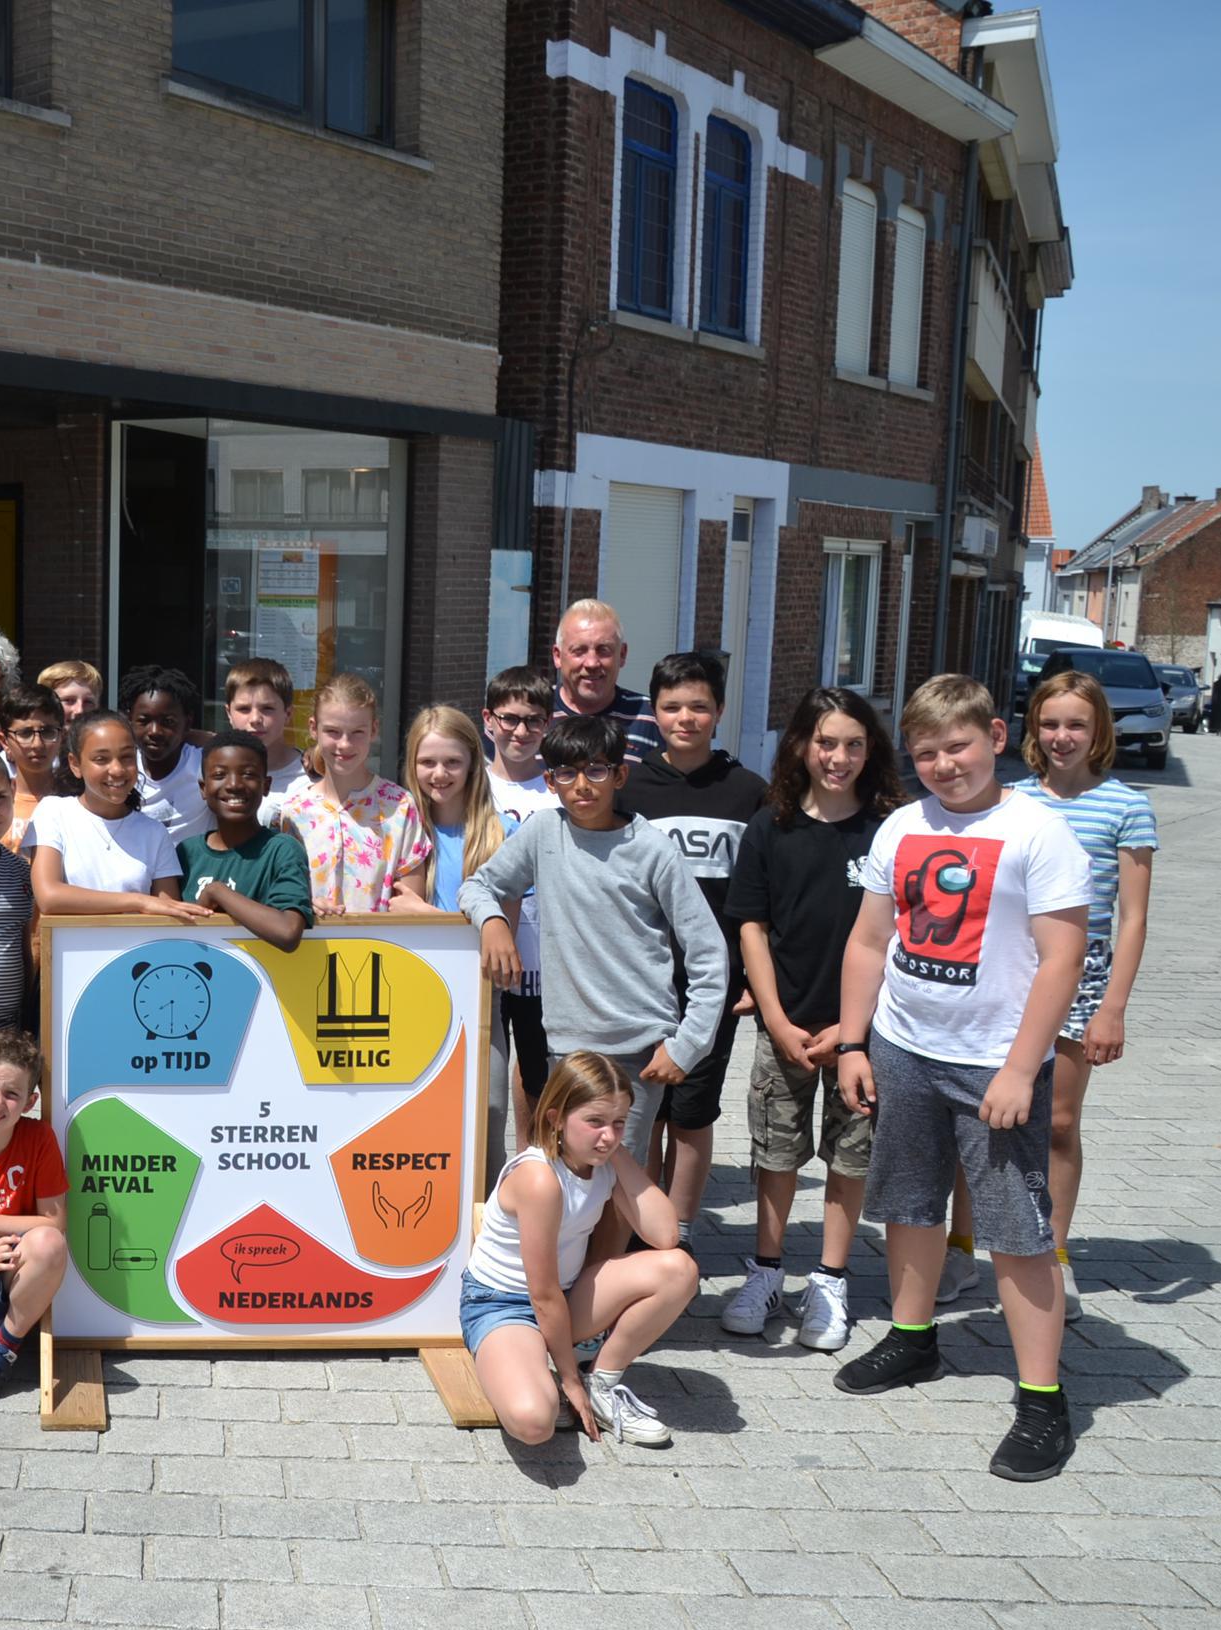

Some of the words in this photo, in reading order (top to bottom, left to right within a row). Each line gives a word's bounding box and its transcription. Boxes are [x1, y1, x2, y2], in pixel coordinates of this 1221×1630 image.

[668, 828, 732, 859] ASA
[131, 1054, 158, 1073] op
[162, 1051, 211, 1072] TIJD
[317, 1050, 391, 1068] VEILIG
[258, 1101, 271, 1118] 5
[210, 1125, 318, 1143] STERREN
[82, 1154, 178, 1173] MINDER
[218, 1152, 311, 1171] SCHOOL
[351, 1152, 451, 1171] RESPECT
[81, 1176, 154, 1194] AFVAL
[234, 1243, 246, 1255] ik
[247, 1243, 287, 1258] spreek
[218, 1291, 374, 1309] NEDERLANDS
